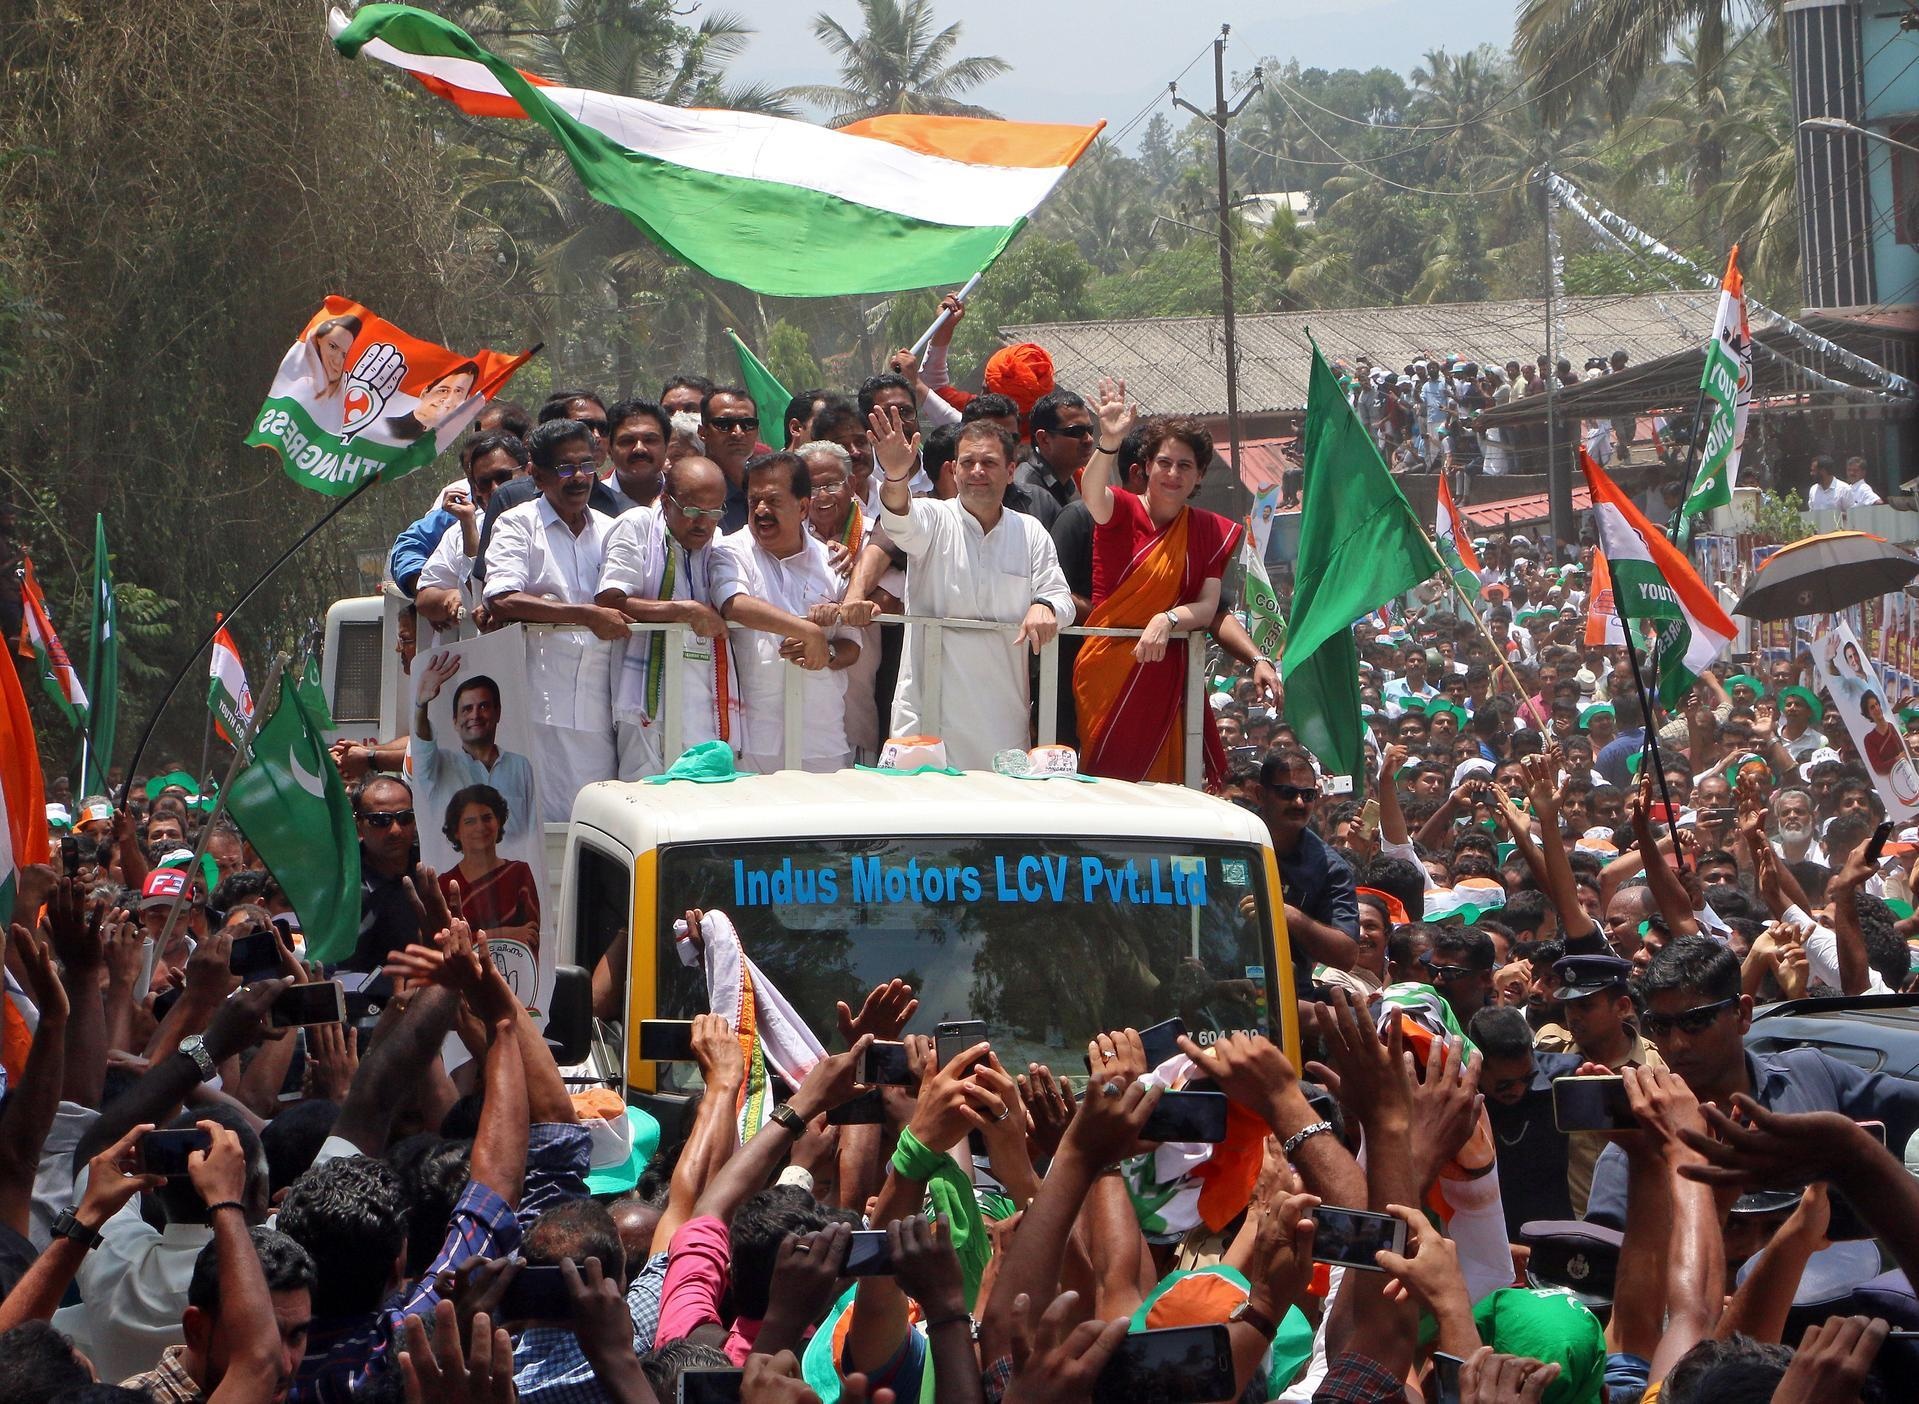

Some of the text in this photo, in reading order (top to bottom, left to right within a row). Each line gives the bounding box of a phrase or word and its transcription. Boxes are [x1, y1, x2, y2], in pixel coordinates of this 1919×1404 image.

[219, 699, 237, 728] YOUTH
[734, 855, 1207, 906] Indus Motors LCV Pvt.Ltd
